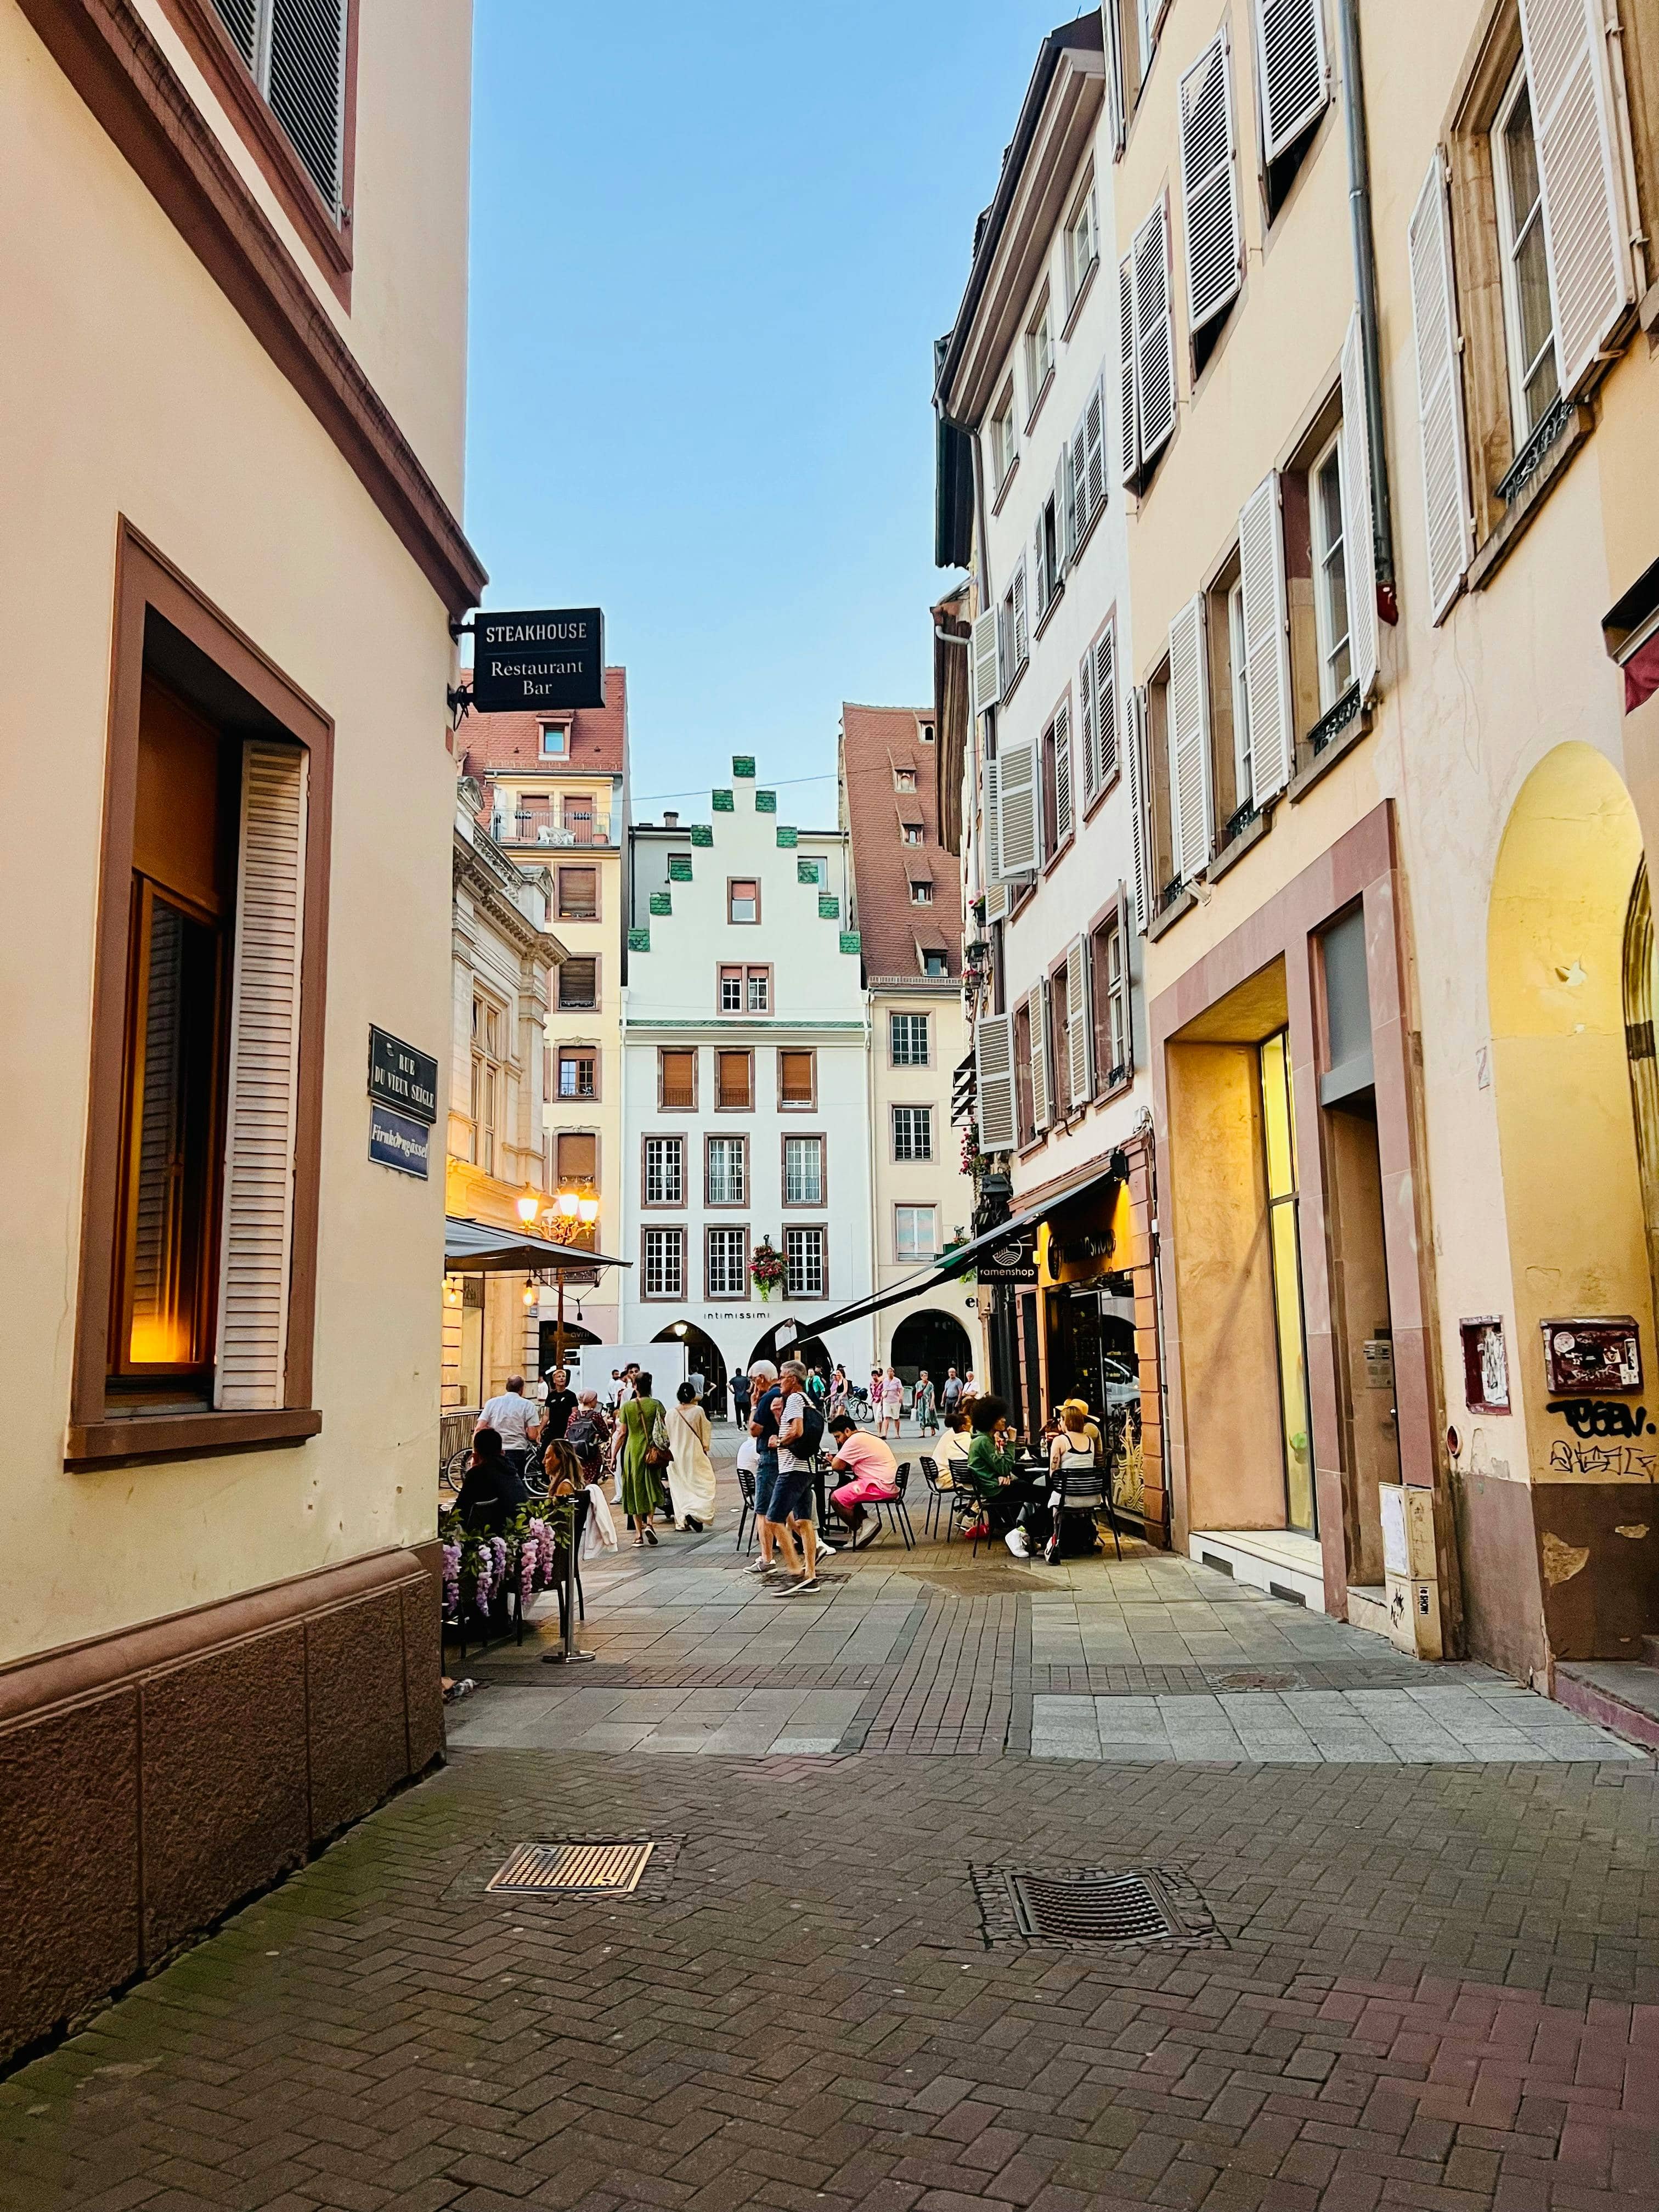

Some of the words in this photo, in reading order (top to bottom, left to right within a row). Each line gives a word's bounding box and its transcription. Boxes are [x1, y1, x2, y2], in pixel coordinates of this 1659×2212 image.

[486, 623, 587, 642] STEAKHOUSE
[492, 661, 583, 676] Restaurant
[523, 680, 552, 695] Bar
[399, 1054, 415, 1075] RUE
[375, 1065, 385, 1085] DU
[387, 1072, 408, 1097] VIEUX
[411, 1084, 435, 1108] SEIGLE
[980, 1267, 1035, 1277] ramenshop
